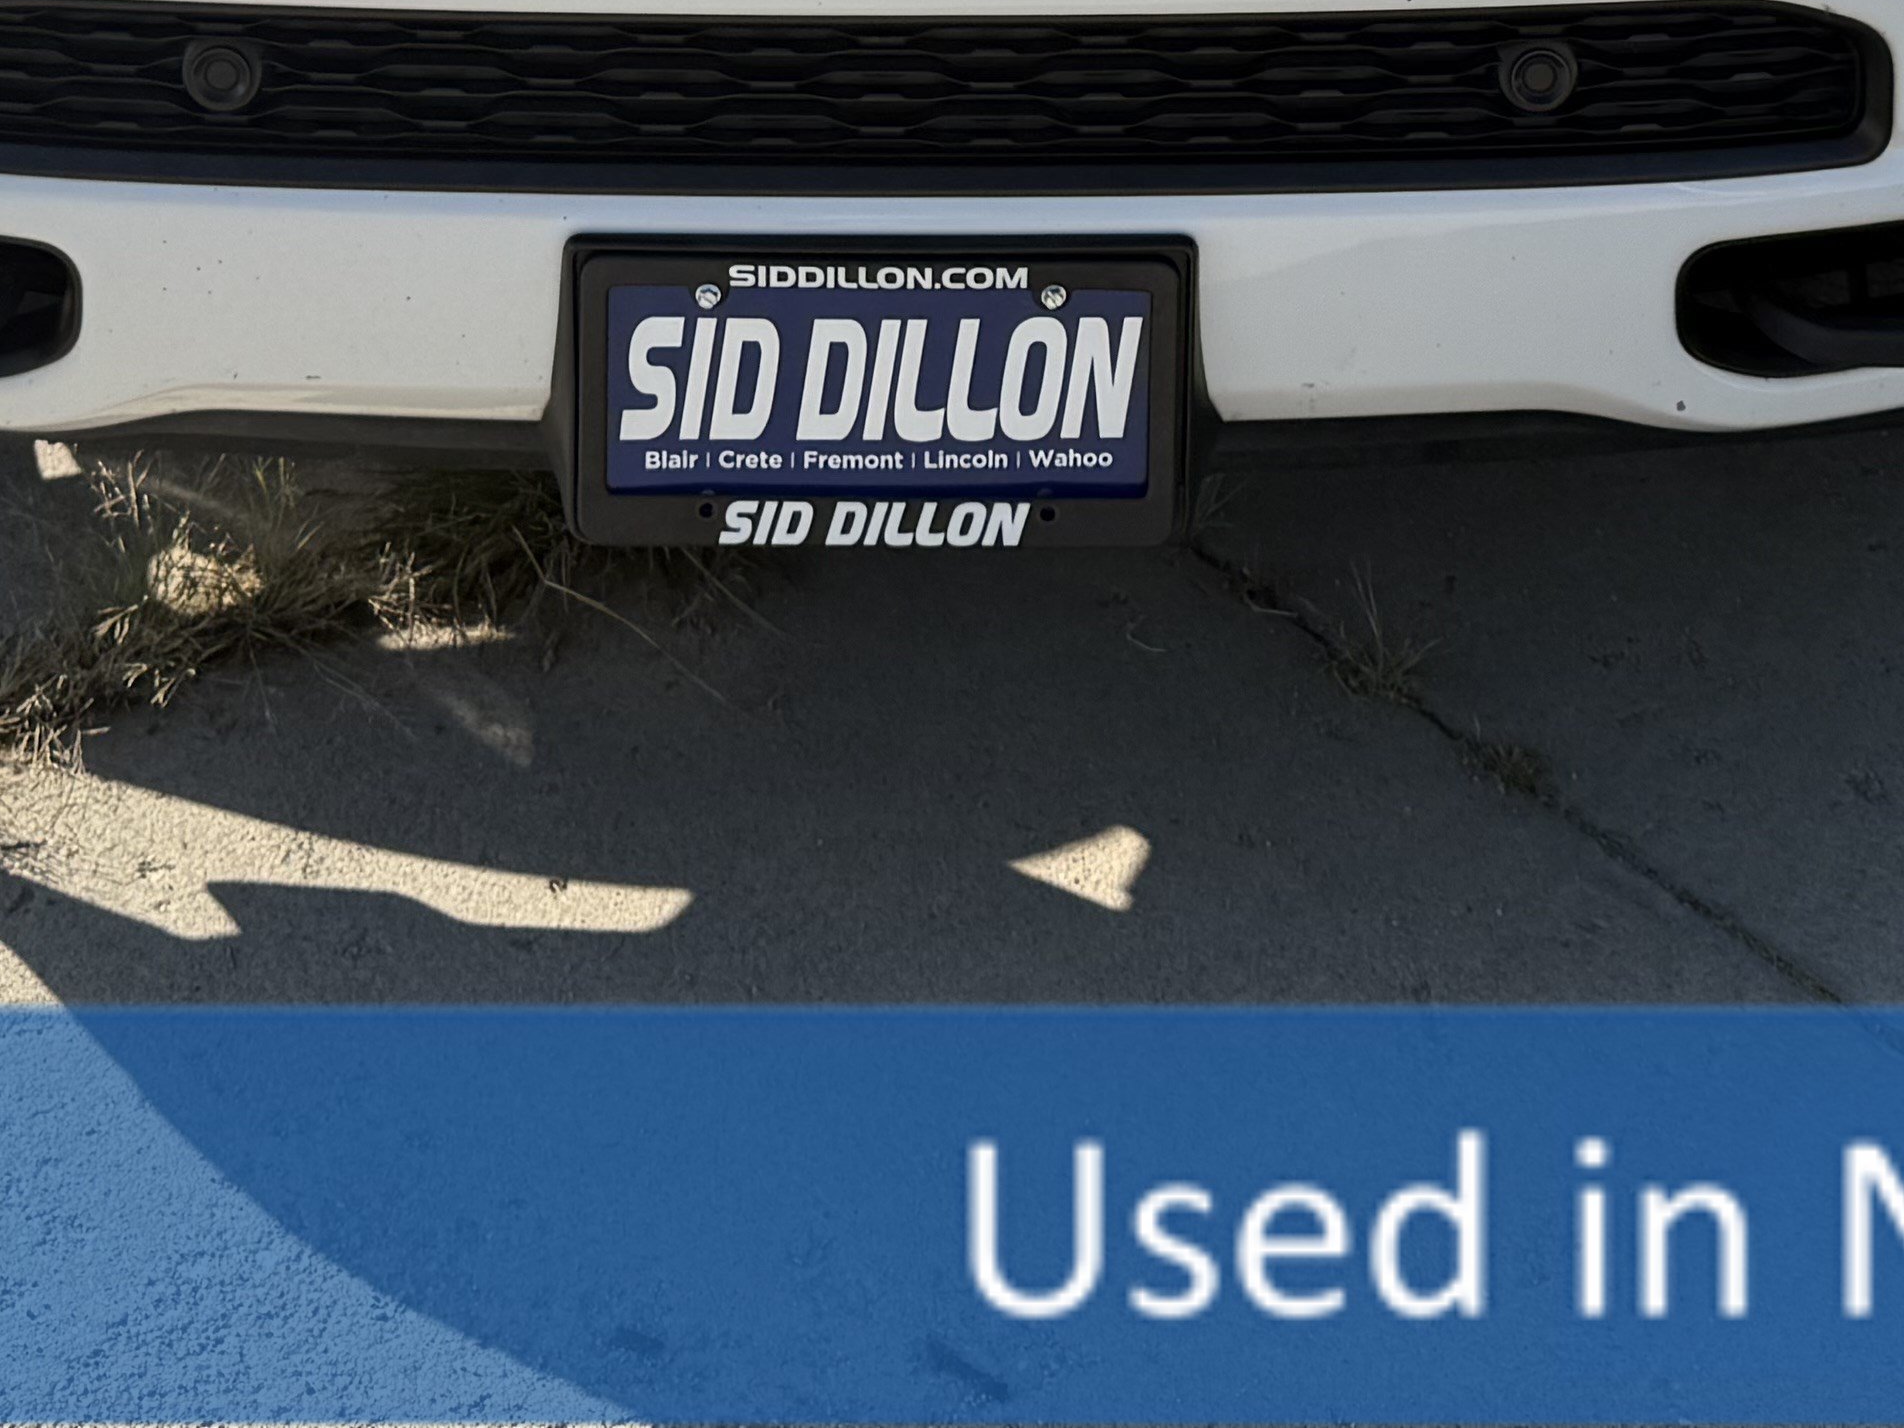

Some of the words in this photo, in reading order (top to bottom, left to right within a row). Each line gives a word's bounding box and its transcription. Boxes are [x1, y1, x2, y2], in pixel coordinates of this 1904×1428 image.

[727, 263, 1029, 291] SIDDILLON.COM
[619, 316, 780, 441] SID
[795, 317, 1144, 443] DILLON
[645, 449, 699, 470] Blair
[718, 450, 783, 469] Crete
[803, 450, 904, 470] Fremont
[924, 449, 1008, 469] Lincoln
[1028, 448, 1113, 468] Wahoo
[718, 500, 814, 546] SID
[825, 501, 1031, 547] DILLON
